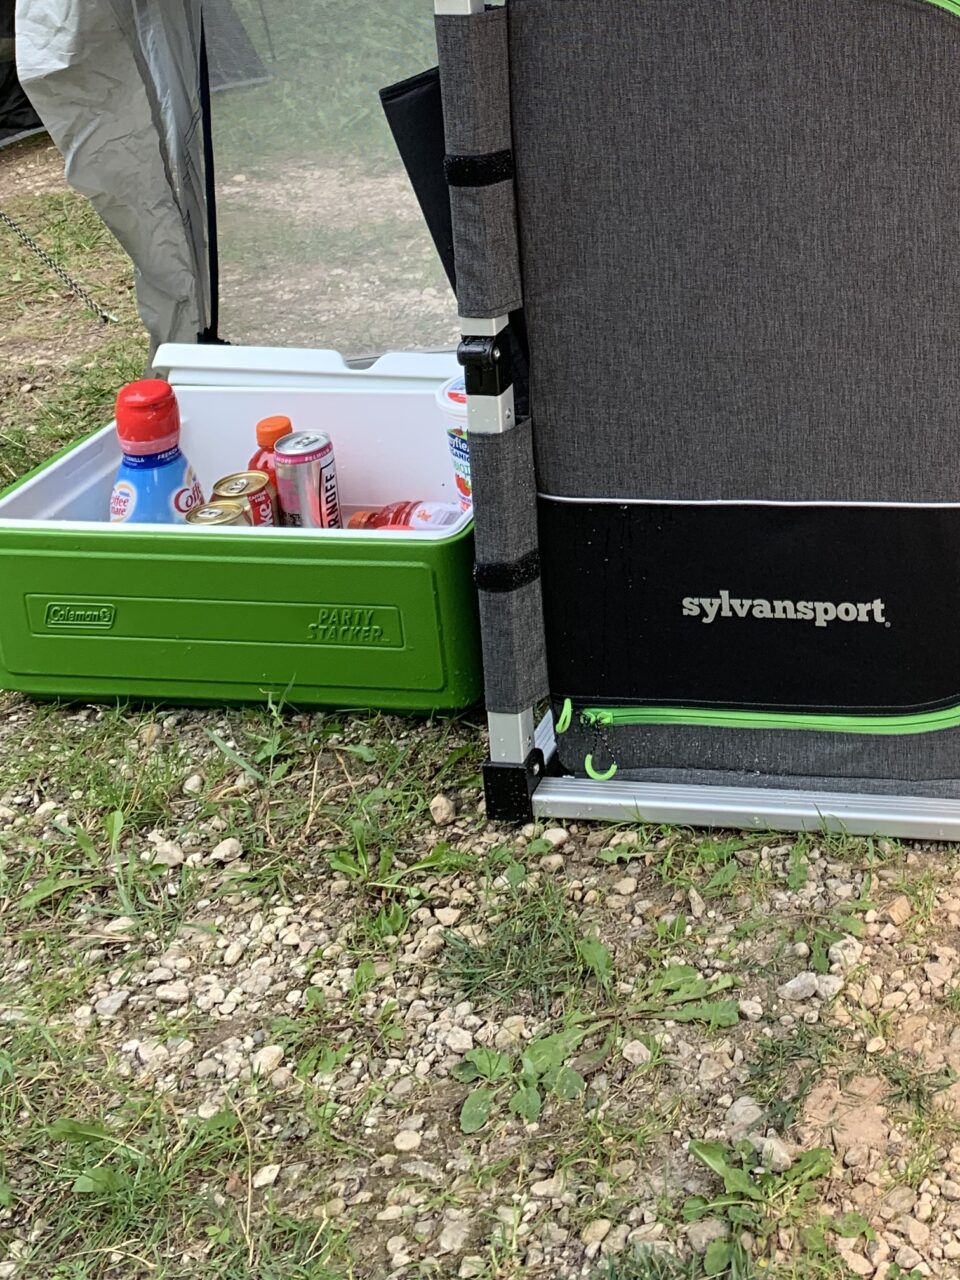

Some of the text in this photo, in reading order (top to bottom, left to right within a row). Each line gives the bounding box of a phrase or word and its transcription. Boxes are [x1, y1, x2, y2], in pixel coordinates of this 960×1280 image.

[50, 606, 99, 622] Coleman
[319, 608, 374, 625] PARTY
[682, 590, 886, 627] sylvansport
[306, 624, 384, 642] STACKER
